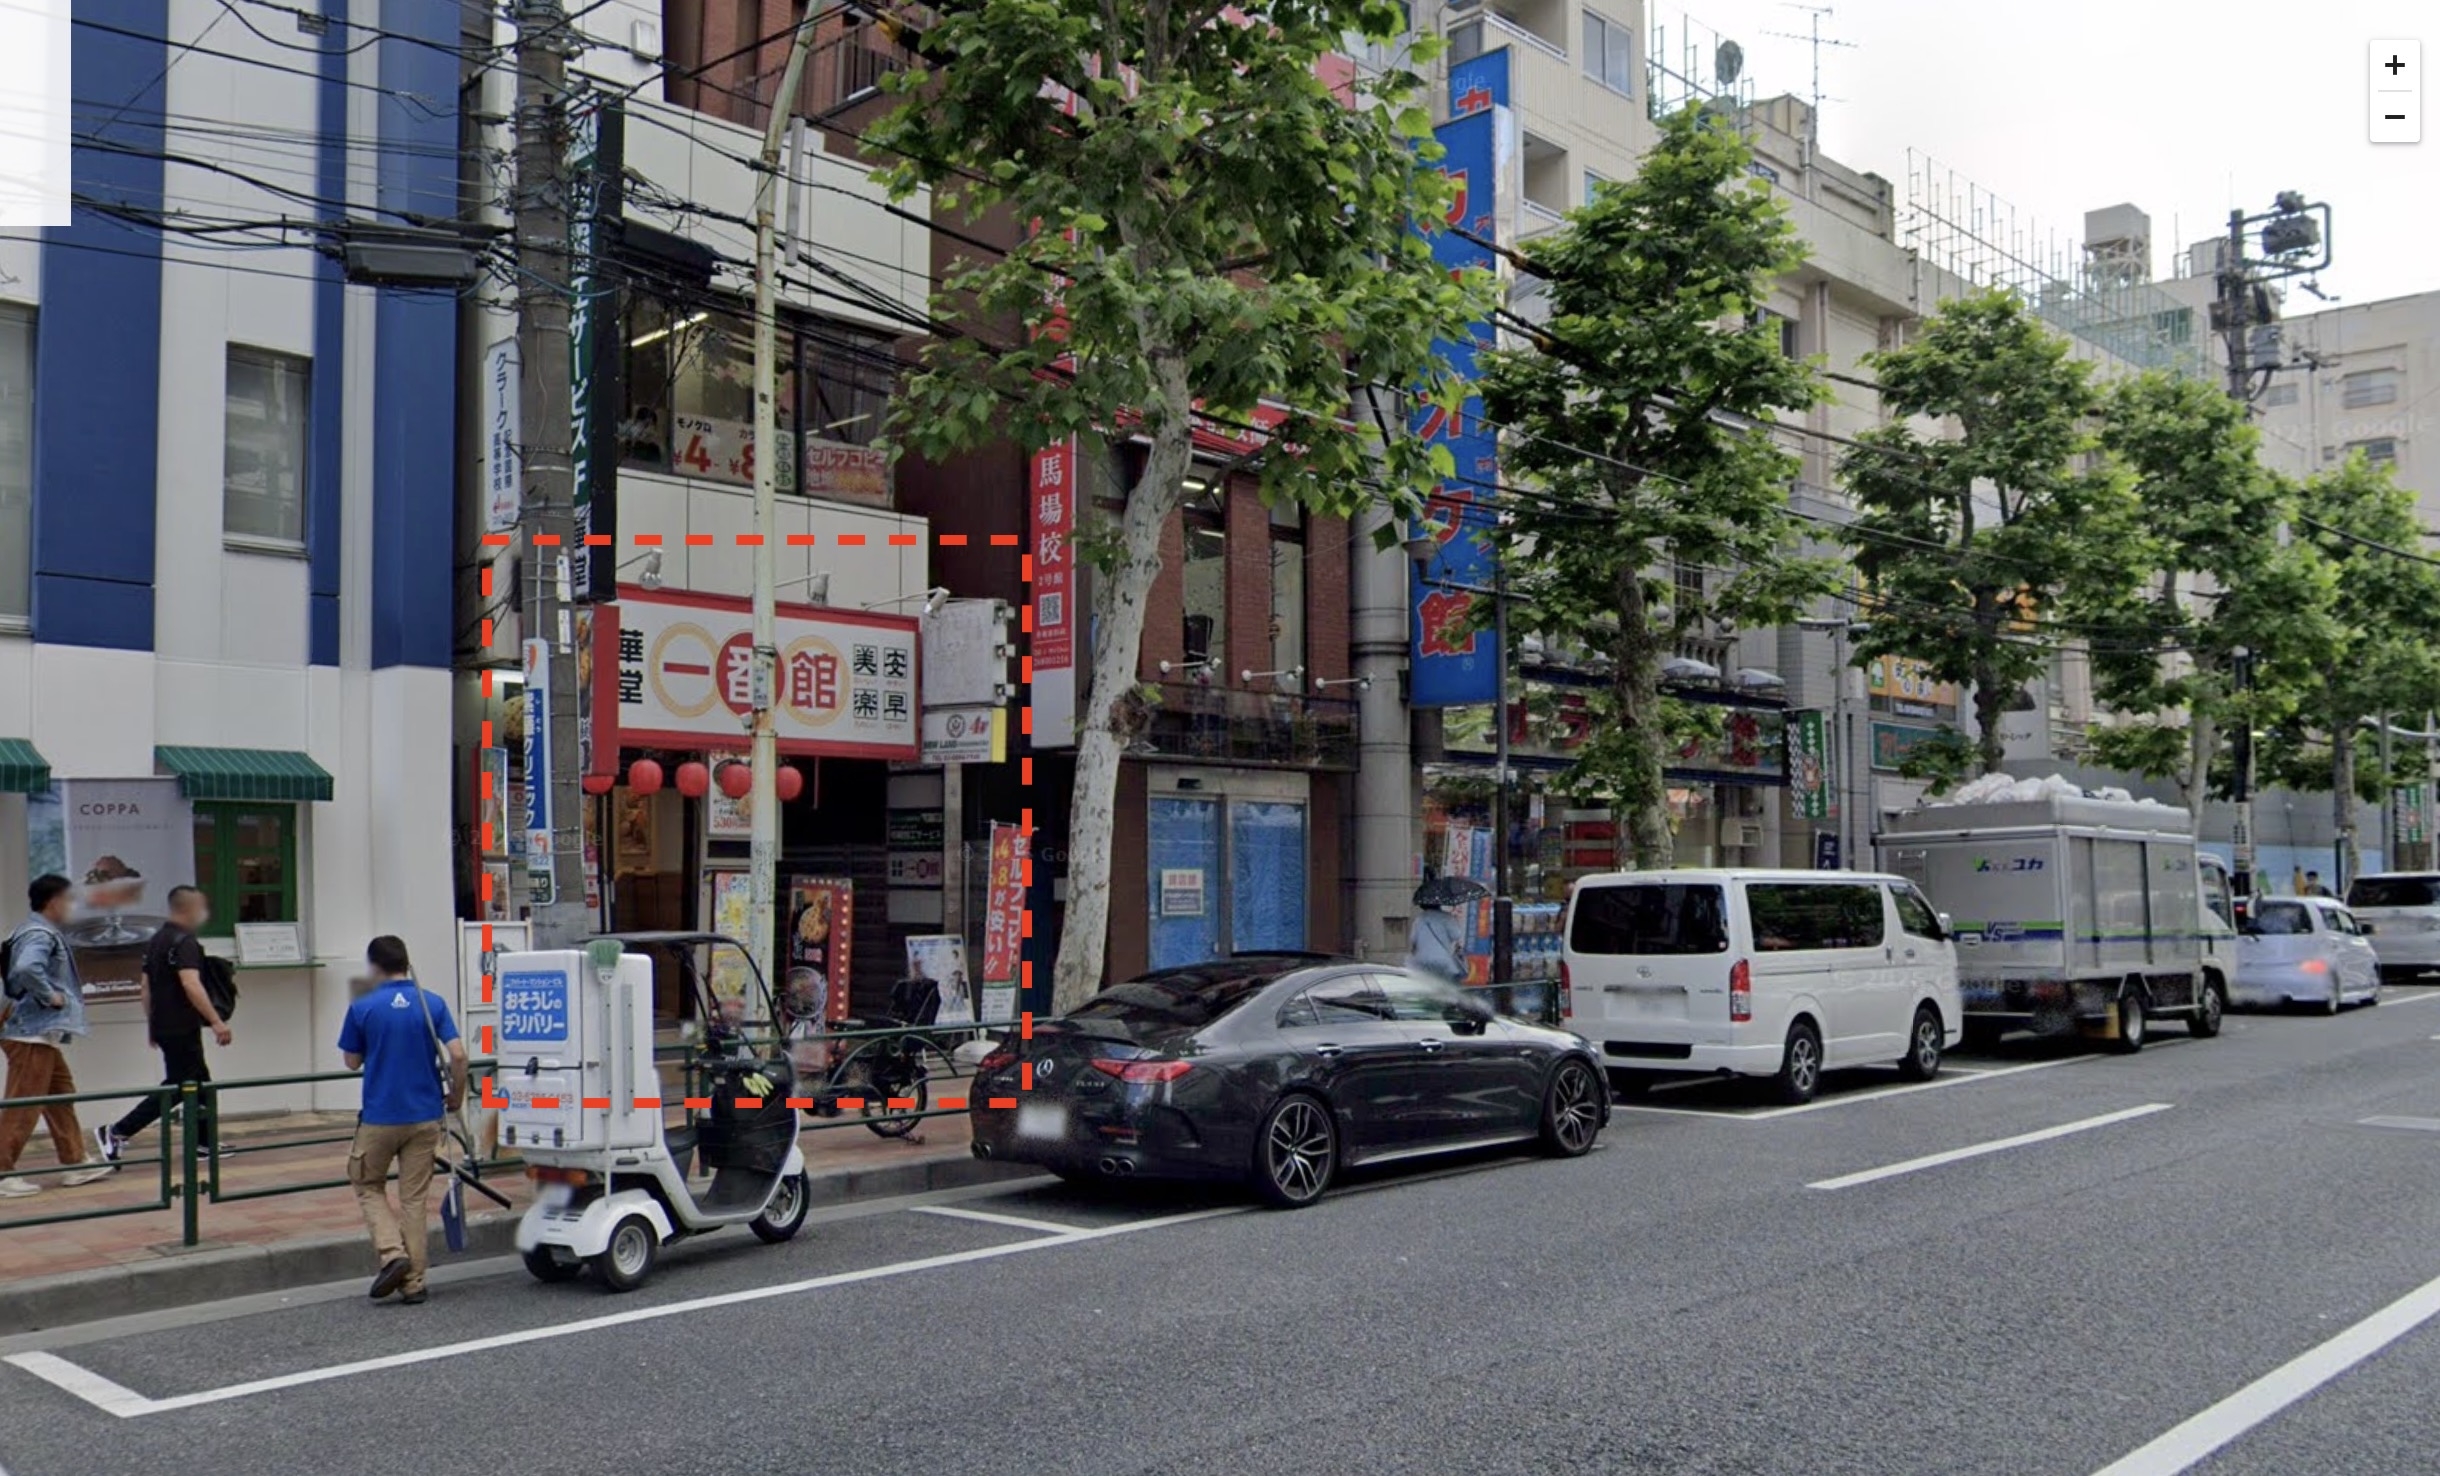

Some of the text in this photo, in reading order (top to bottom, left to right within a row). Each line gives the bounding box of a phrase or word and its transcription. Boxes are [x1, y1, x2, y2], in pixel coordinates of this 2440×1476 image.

[494, 350, 509, 430] クラーク
[677, 418, 712, 433] モノクロ
[79, 802, 141, 816] COPPA
[504, 990, 563, 1011] おそうじの
[503, 1012, 565, 1035] デリバリー
